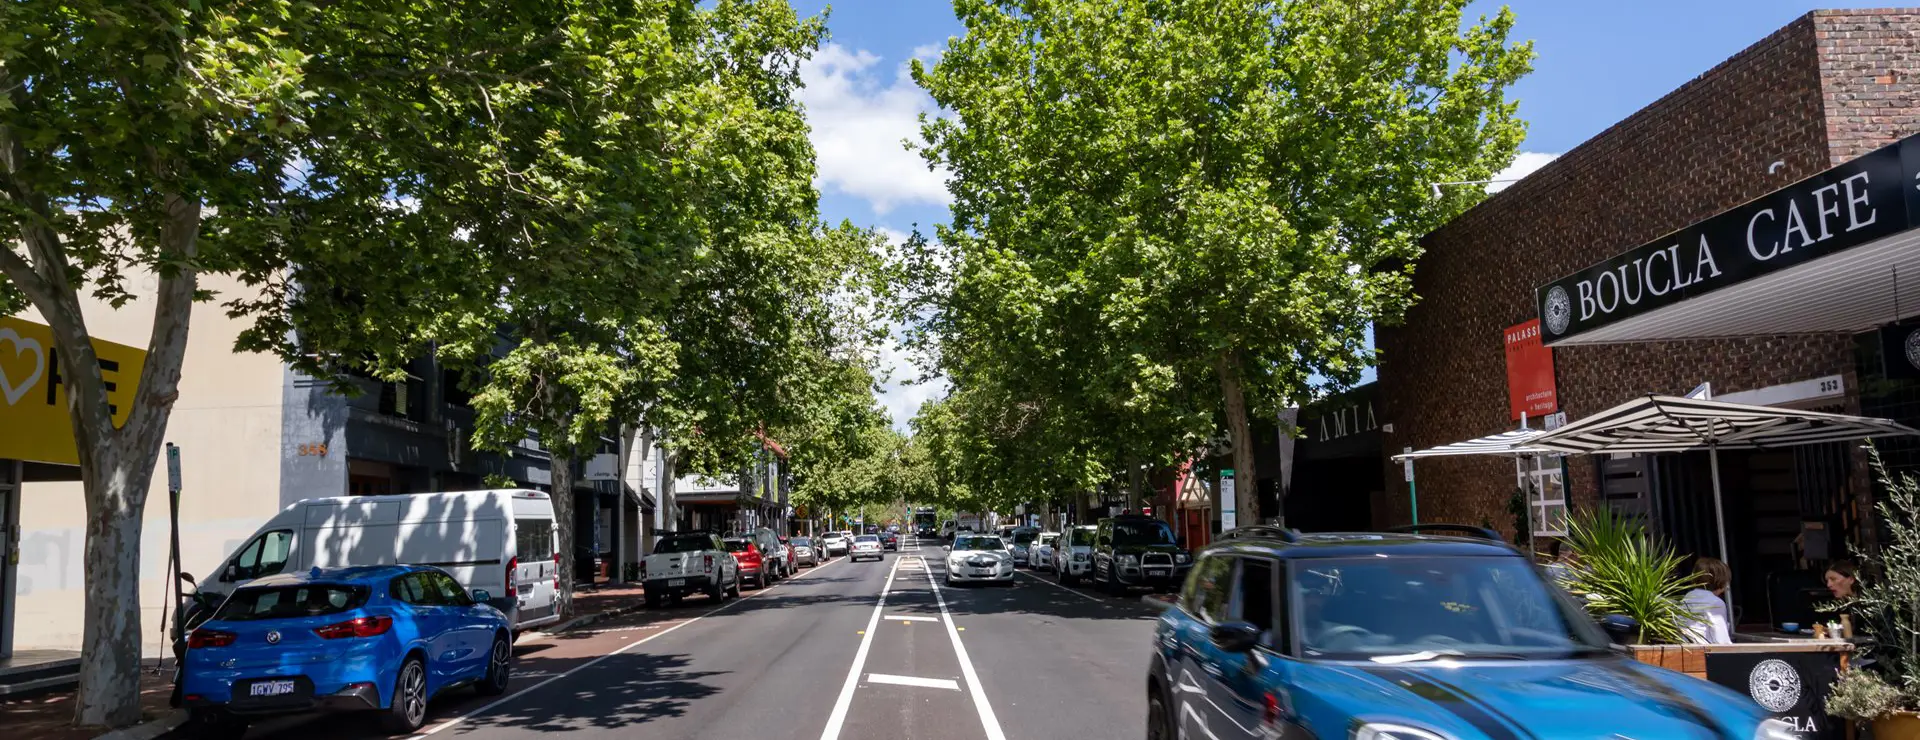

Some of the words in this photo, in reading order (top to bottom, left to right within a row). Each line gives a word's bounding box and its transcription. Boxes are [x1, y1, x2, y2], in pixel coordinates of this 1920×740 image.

[1576, 233, 1722, 321] BOUCLA
[1746, 171, 1876, 261] CAFE
[1820, 379, 1838, 393] 353
[1320, 401, 1378, 442] AMIA
